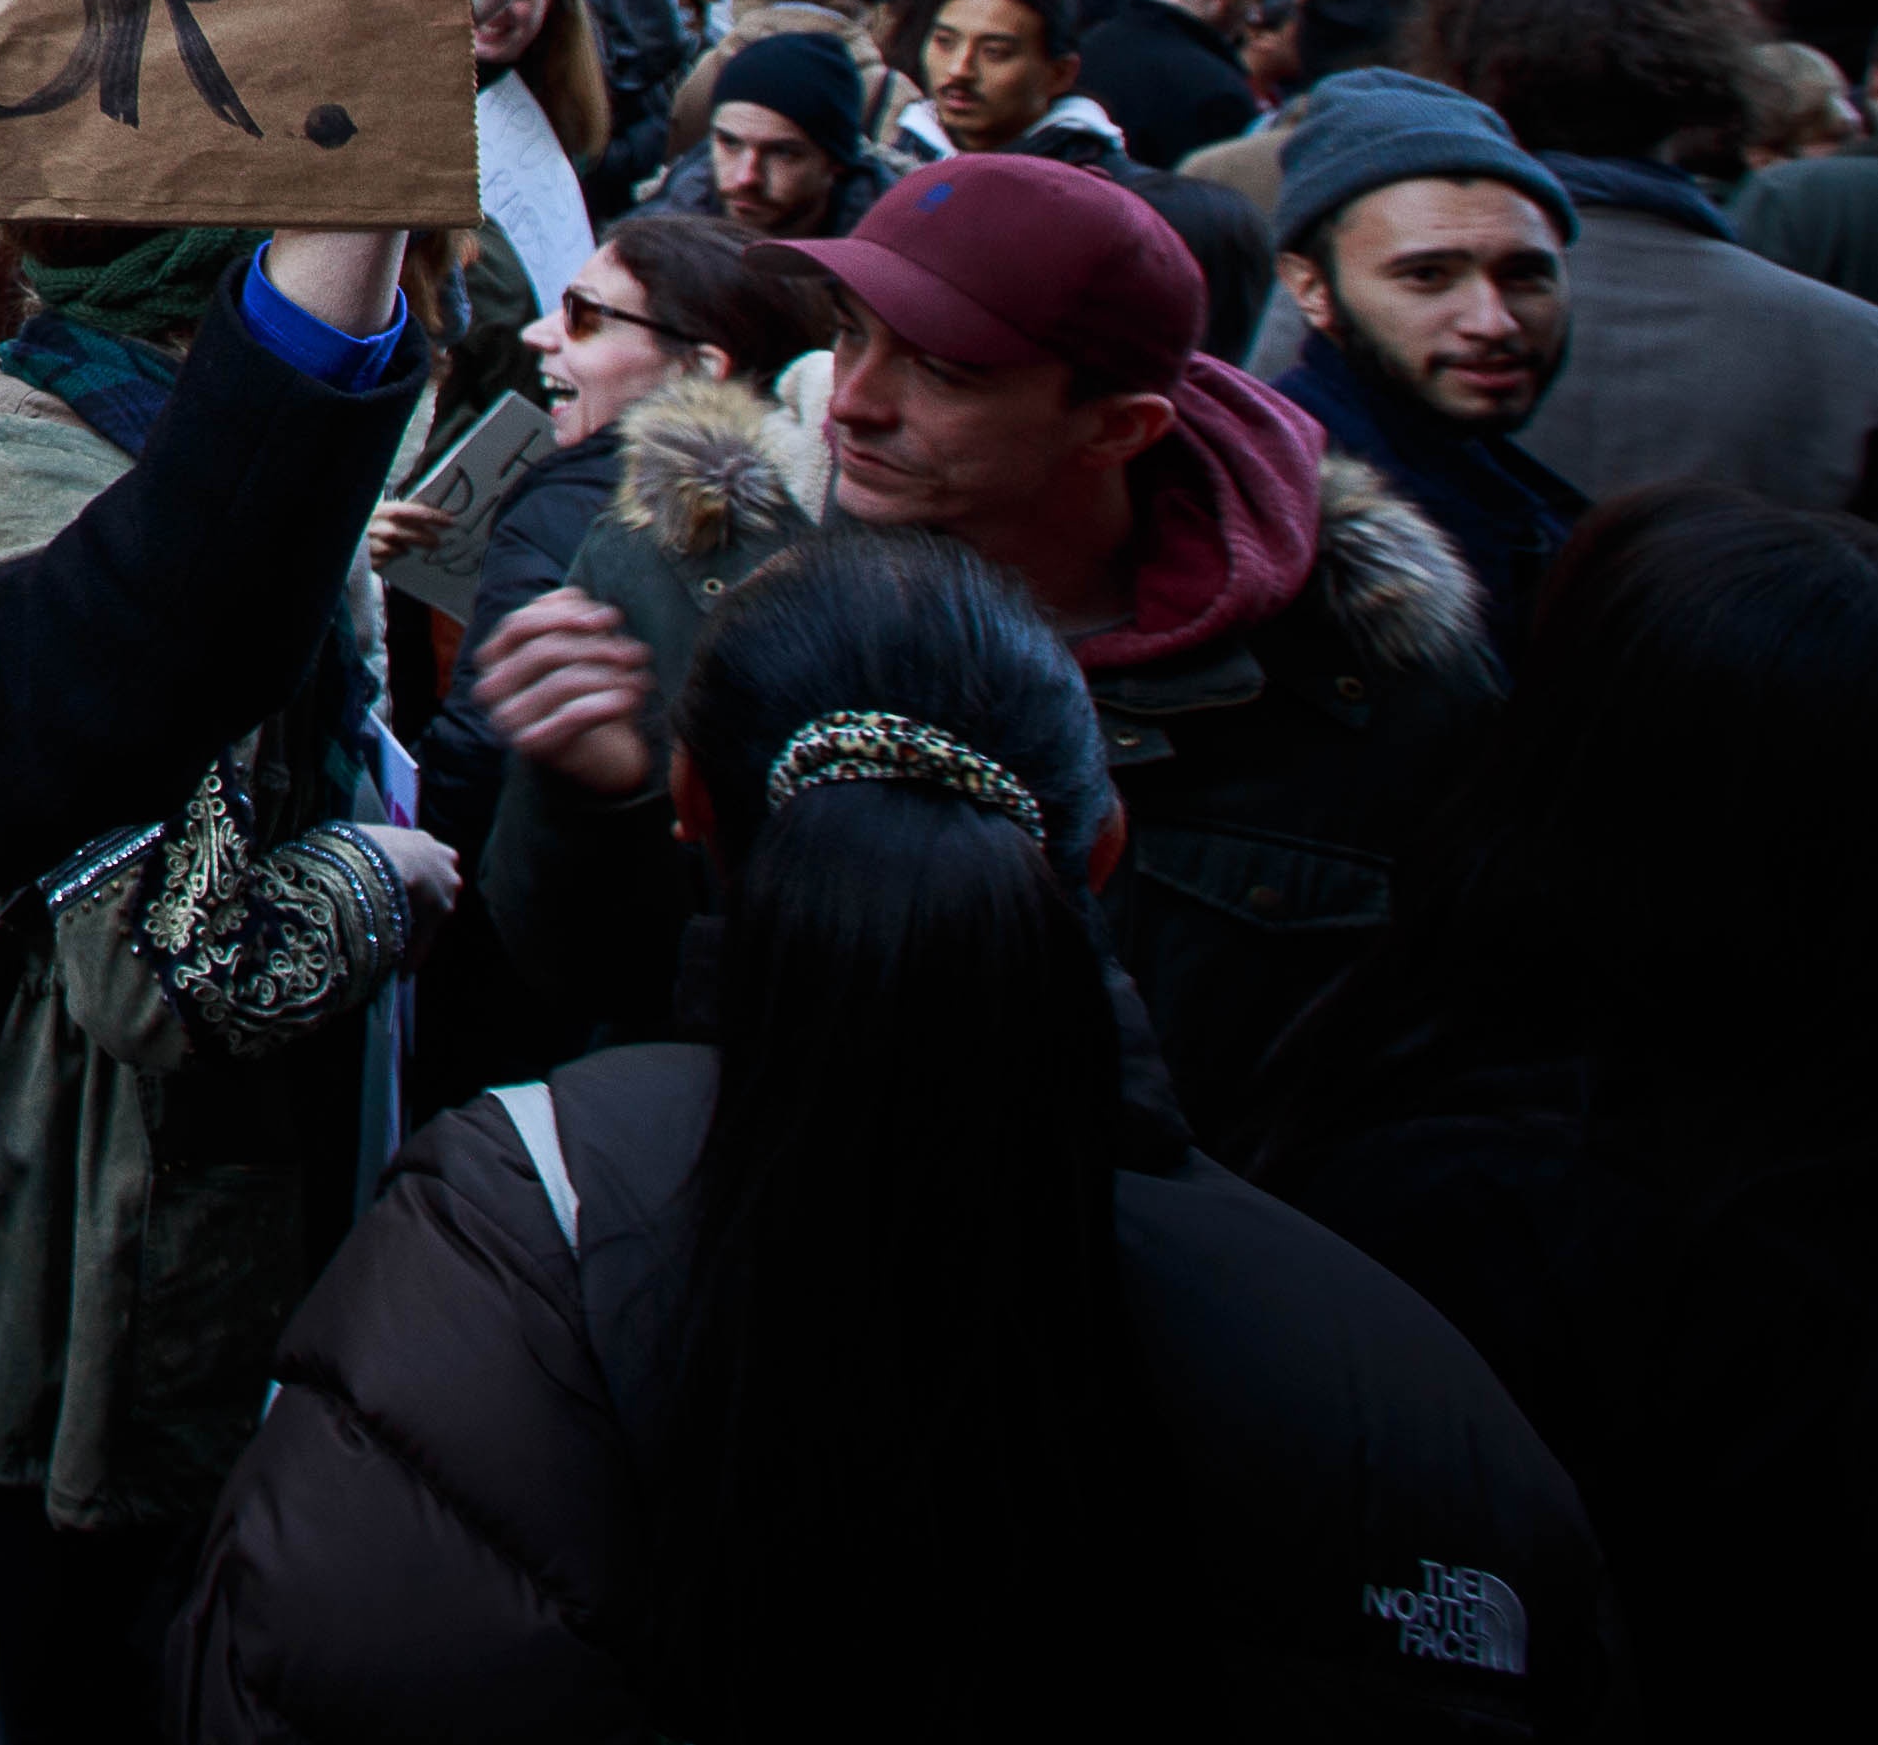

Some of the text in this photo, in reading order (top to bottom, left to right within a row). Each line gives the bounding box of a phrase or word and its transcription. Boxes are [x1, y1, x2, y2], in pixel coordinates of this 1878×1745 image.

[1417, 1556, 1483, 1601] THE
[1361, 1583, 1477, 1630] NORTH
[1398, 1623, 1481, 1664] FACE
